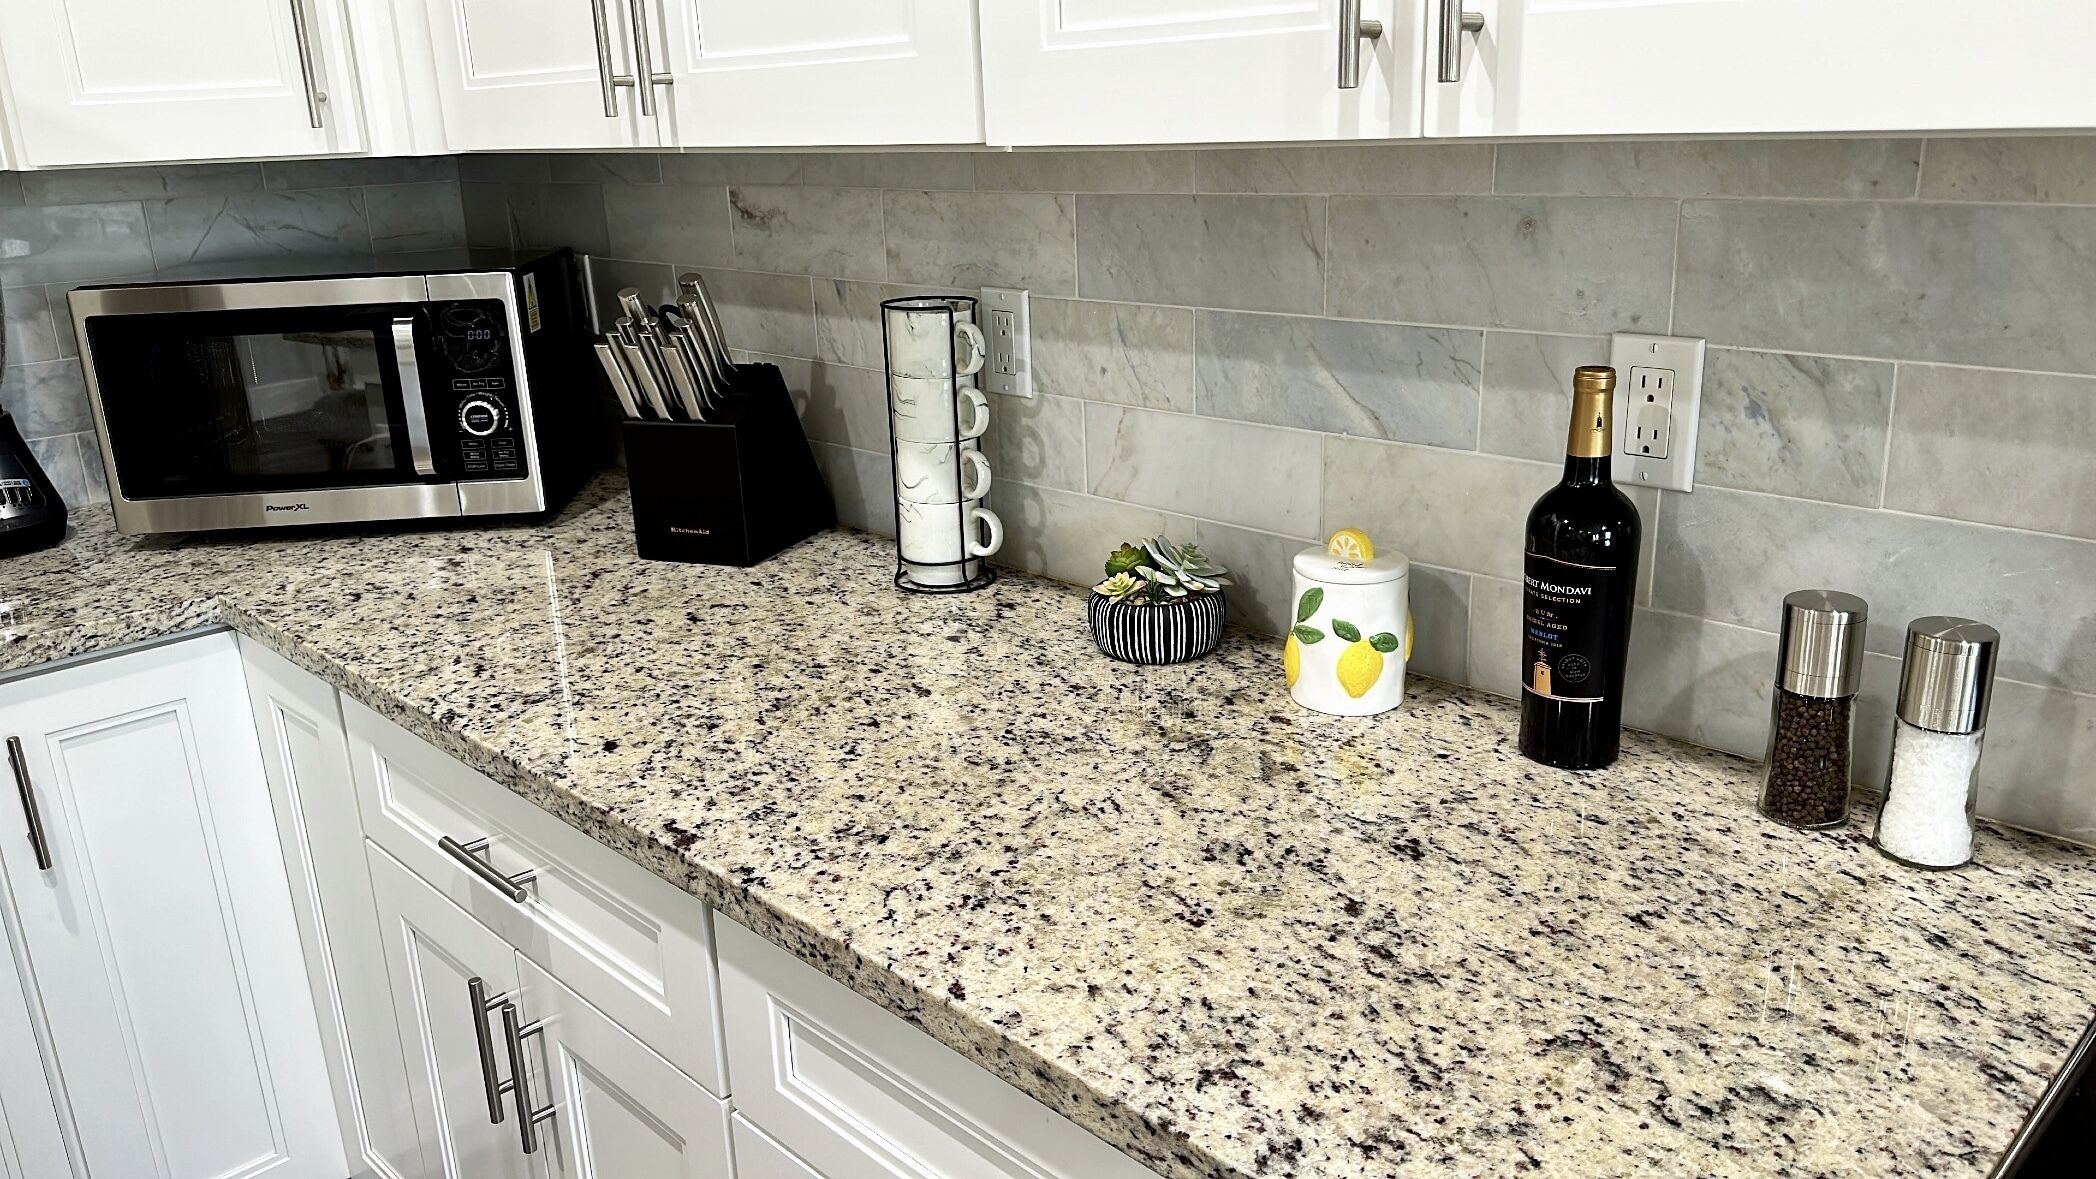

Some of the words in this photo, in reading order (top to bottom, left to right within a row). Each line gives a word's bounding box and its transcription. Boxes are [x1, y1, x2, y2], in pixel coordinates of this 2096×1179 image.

[467, 330, 491, 340] 0:00
[265, 503, 310, 512] PowerXL
[670, 526, 710, 535] KitchenAid
[1525, 574, 1540, 588] BERT
[1540, 581, 1592, 595] MONDAVI
[1540, 593, 1581, 604] SELECTION
[1546, 622, 1568, 631] AGED
[1530, 627, 1559, 641] MERLOT
